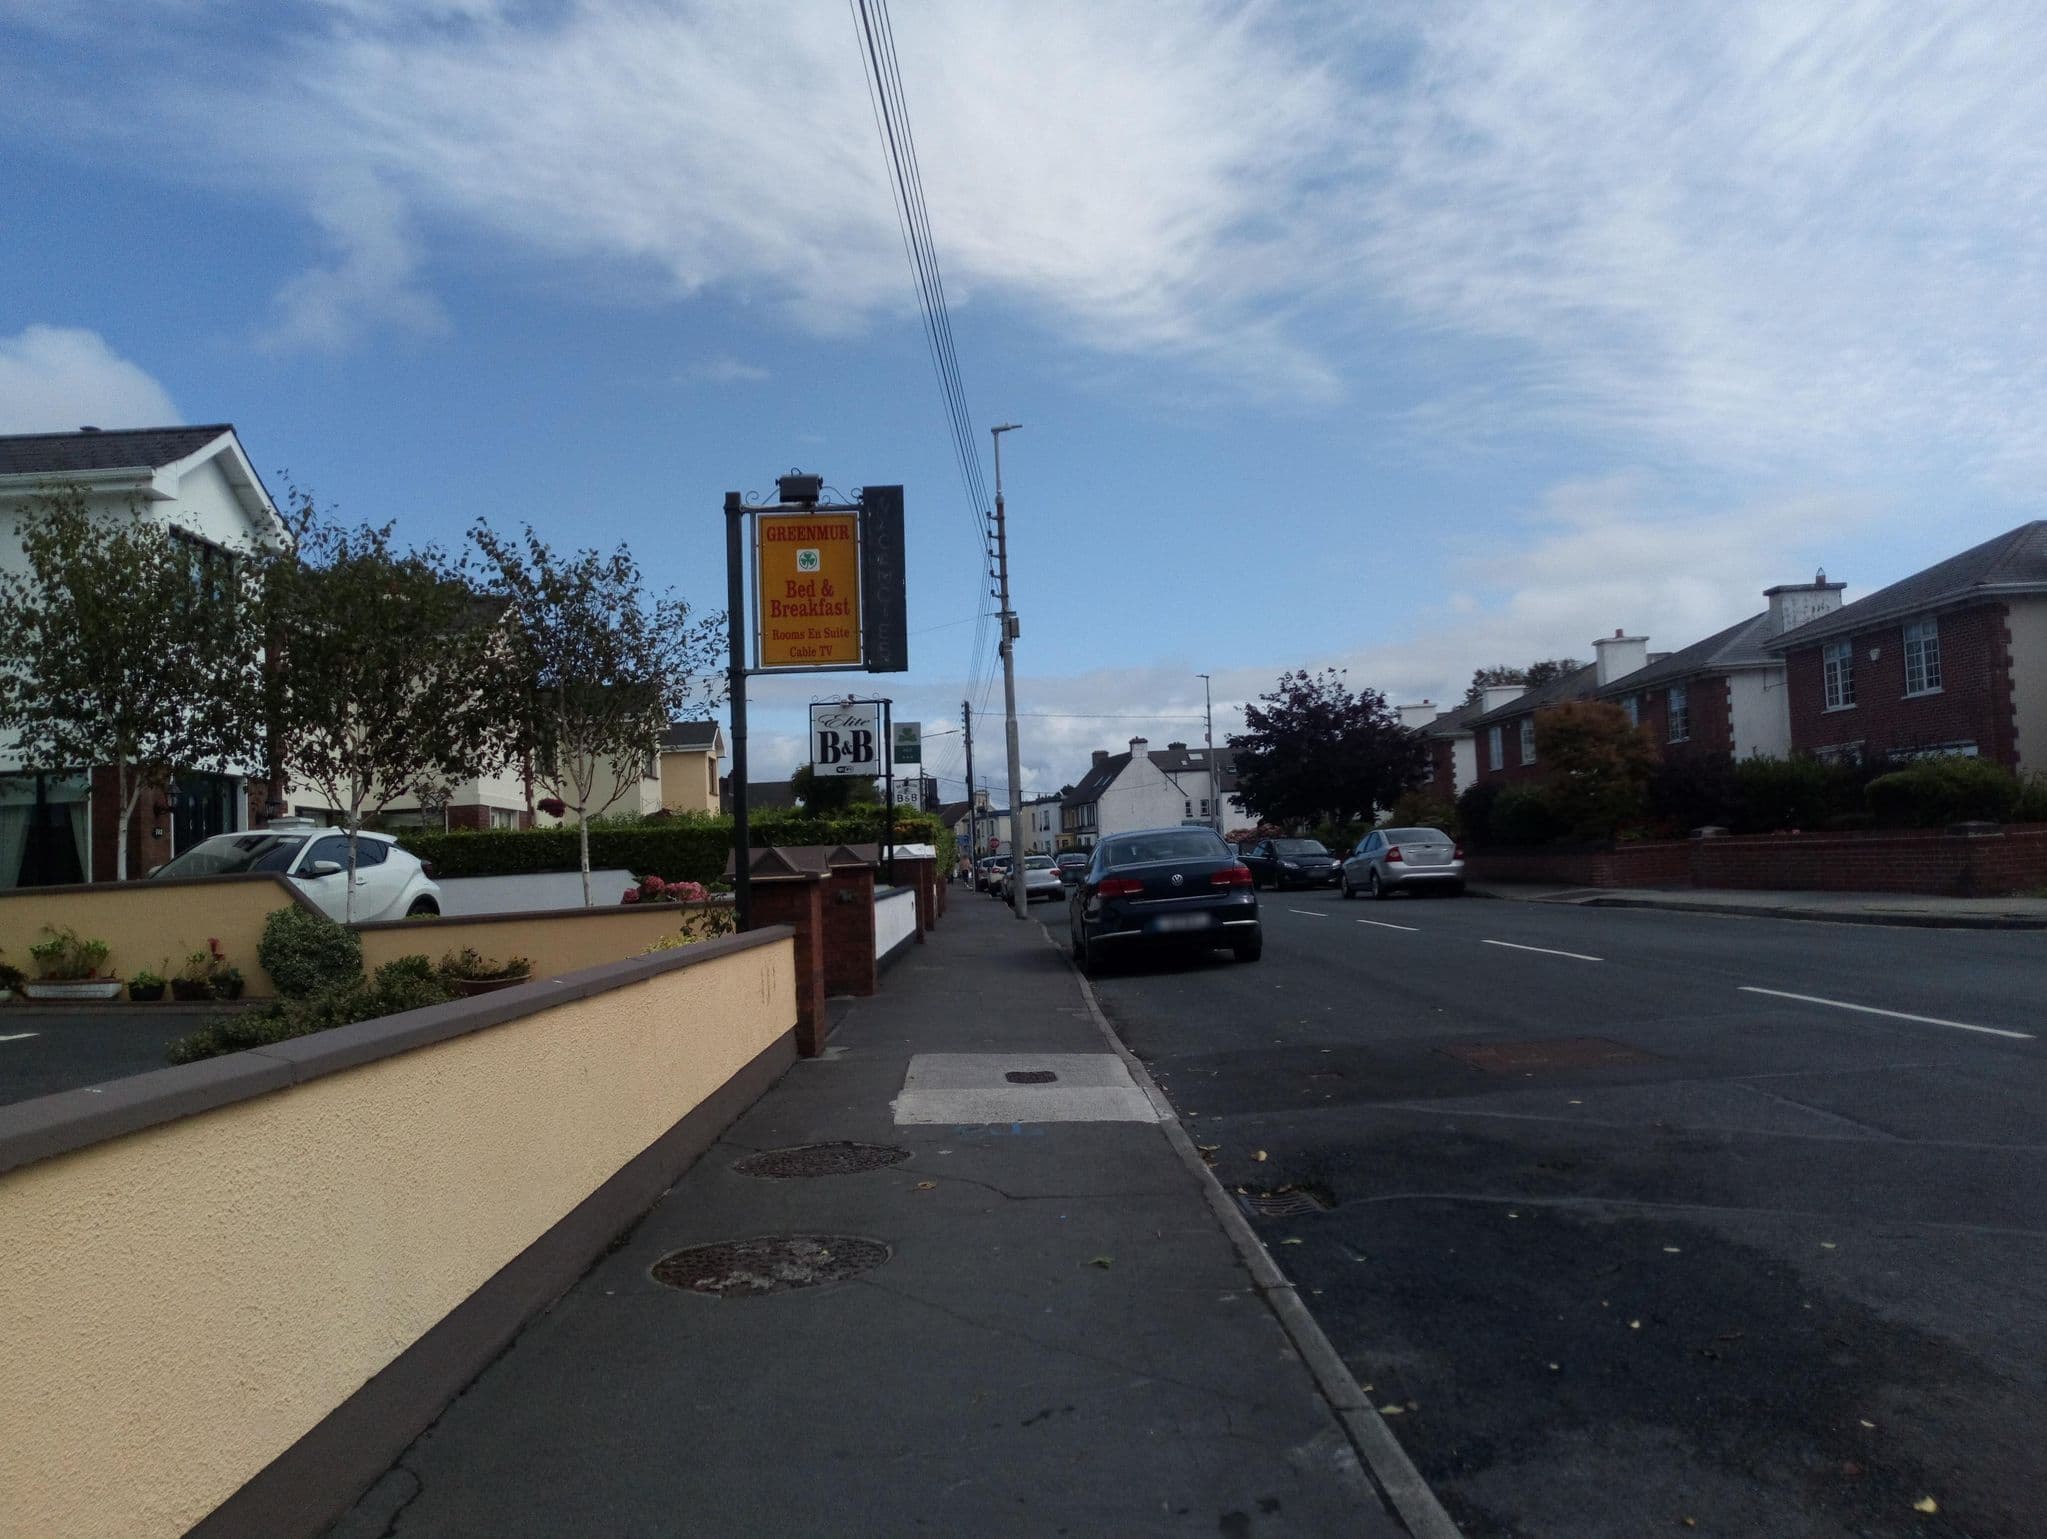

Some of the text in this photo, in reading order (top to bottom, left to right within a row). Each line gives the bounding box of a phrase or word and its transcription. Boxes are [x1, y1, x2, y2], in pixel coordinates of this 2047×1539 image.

[766, 524, 850, 542] GREENMUR
[786, 578, 834, 598] Bed &
[770, 597, 850, 618] Breakfast
[772, 628, 850, 641] Rooms En Suite
[789, 645, 833, 658] Cable TV
[817, 713, 871, 729] Elite
[817, 729, 874, 764] B&B
